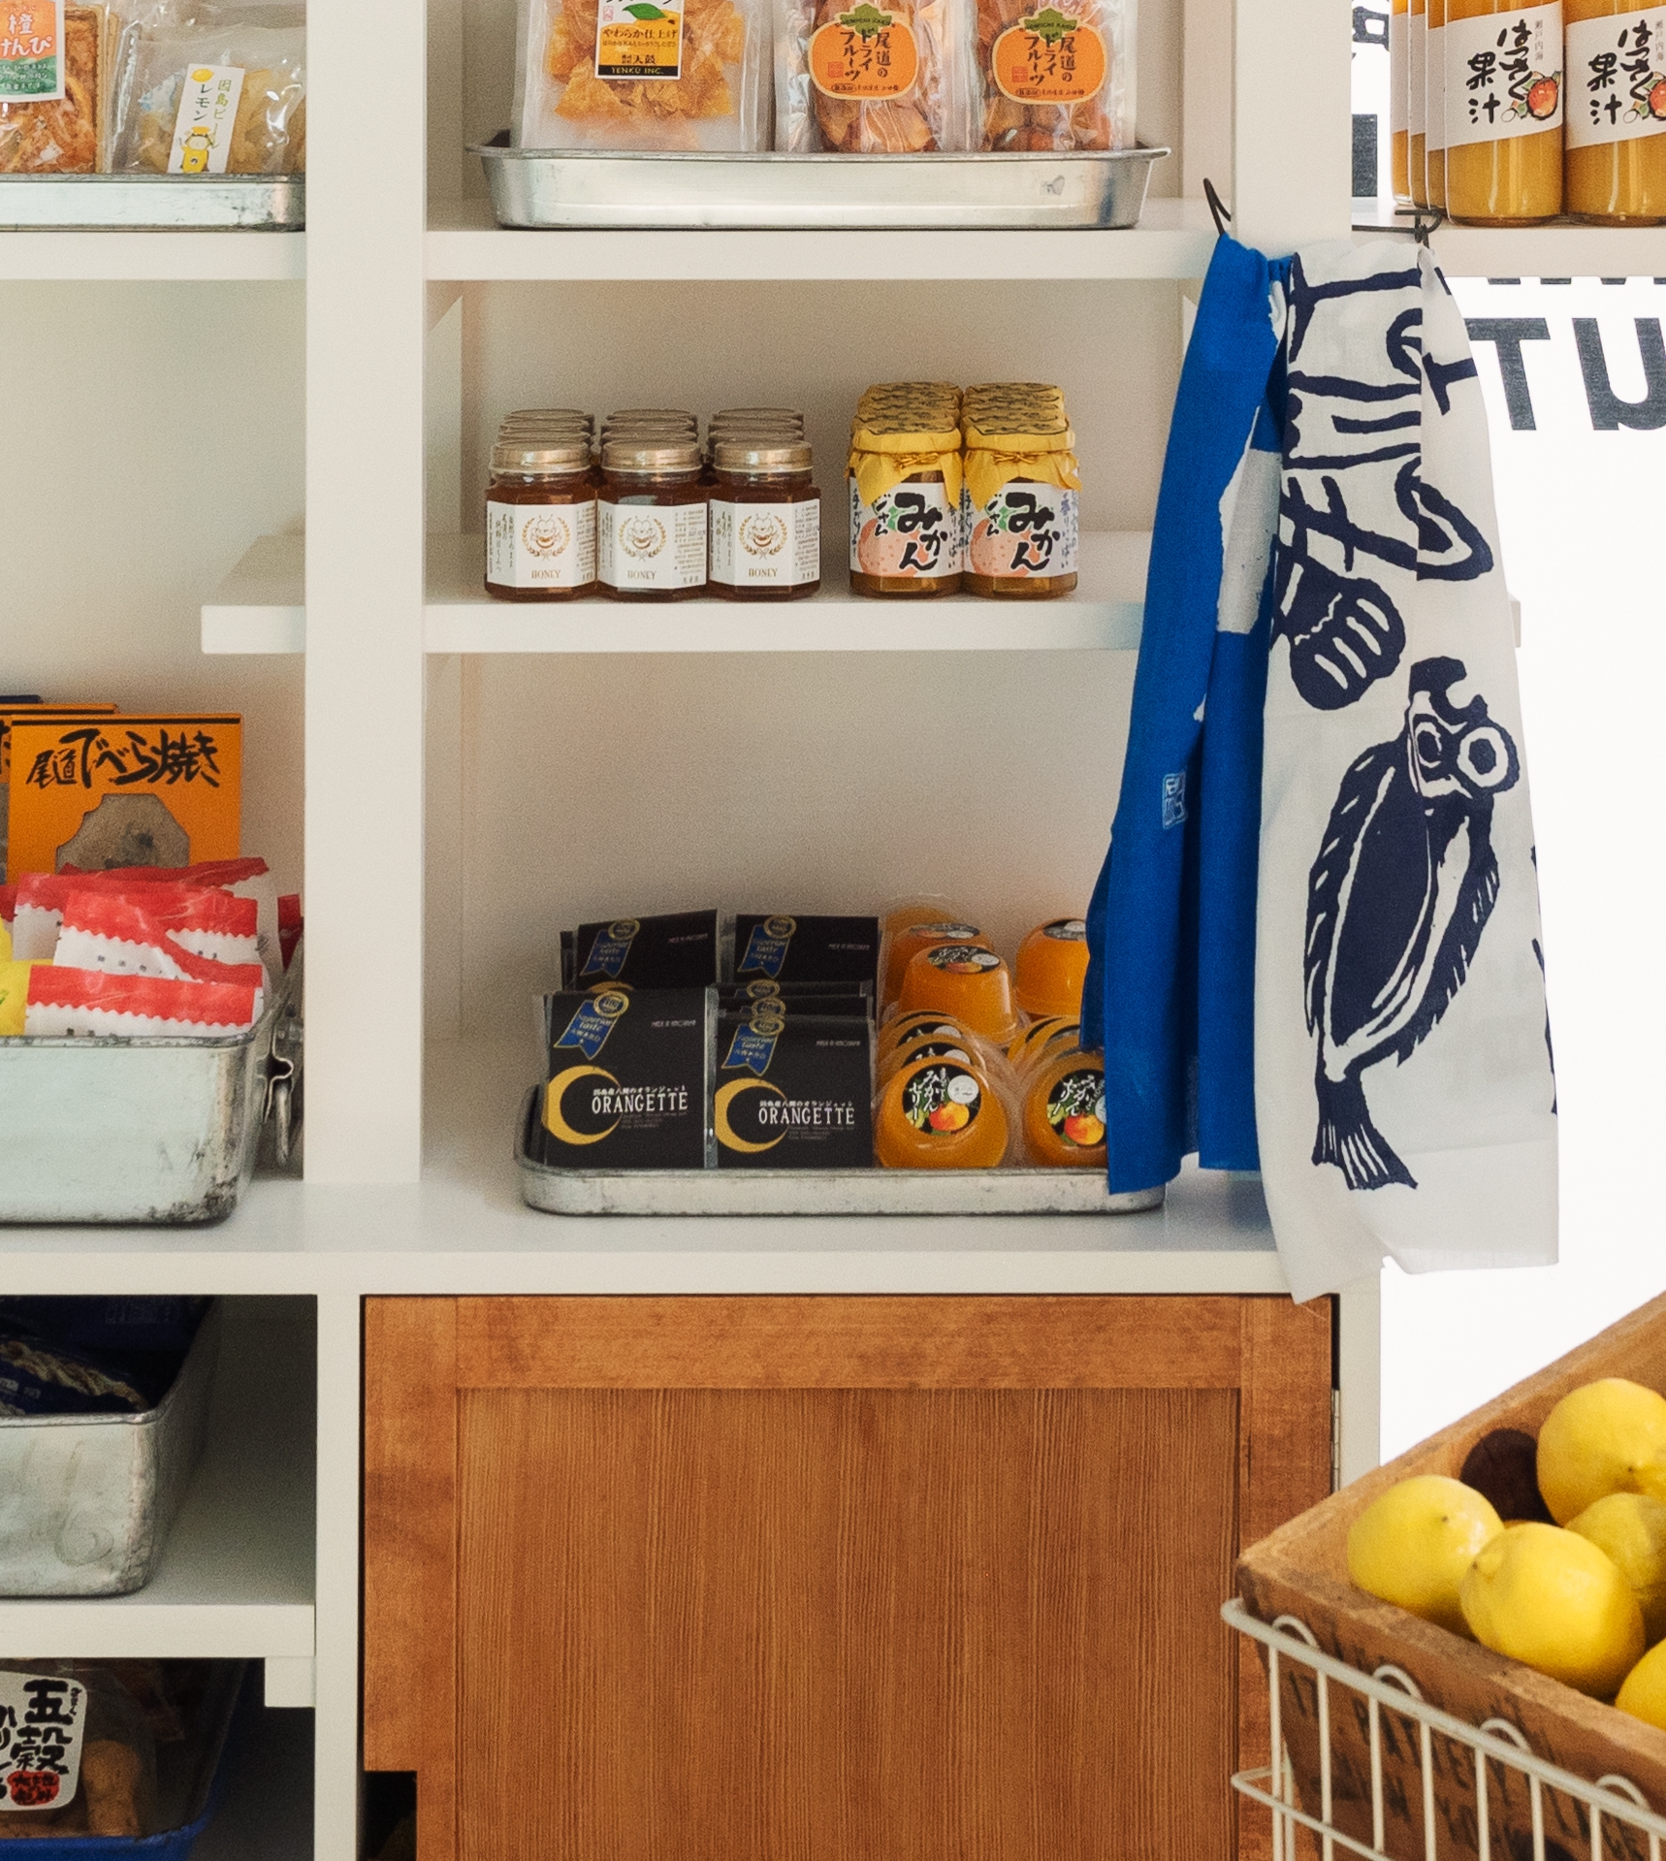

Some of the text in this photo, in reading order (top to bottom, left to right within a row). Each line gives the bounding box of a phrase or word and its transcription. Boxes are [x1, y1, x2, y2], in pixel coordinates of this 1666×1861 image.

[9, 13, 34, 34] 橙
[840, 32, 861, 81] フルーツ
[875, 32, 892, 78] 尾道の
[1024, 36, 1045, 86] フルーツ
[1059, 37, 1077, 83] 尾道の
[1497, 19, 1533, 101] はっさく
[1617, 19, 1653, 102] はっさく
[192, 84, 211, 121] レモン
[1466, 51, 1501, 124] 果汁
[1586, 52, 1623, 125] 果汁
[894, 492, 949, 571] みかん
[1005, 492, 1061, 571] みかん
[26, 727, 221, 789] 尾道でべら焼き
[591, 1092, 689, 1115] ORANGETTE
[758, 1106, 856, 1126] ORANGETTE
[10, 1678, 74, 1775] 五穀
